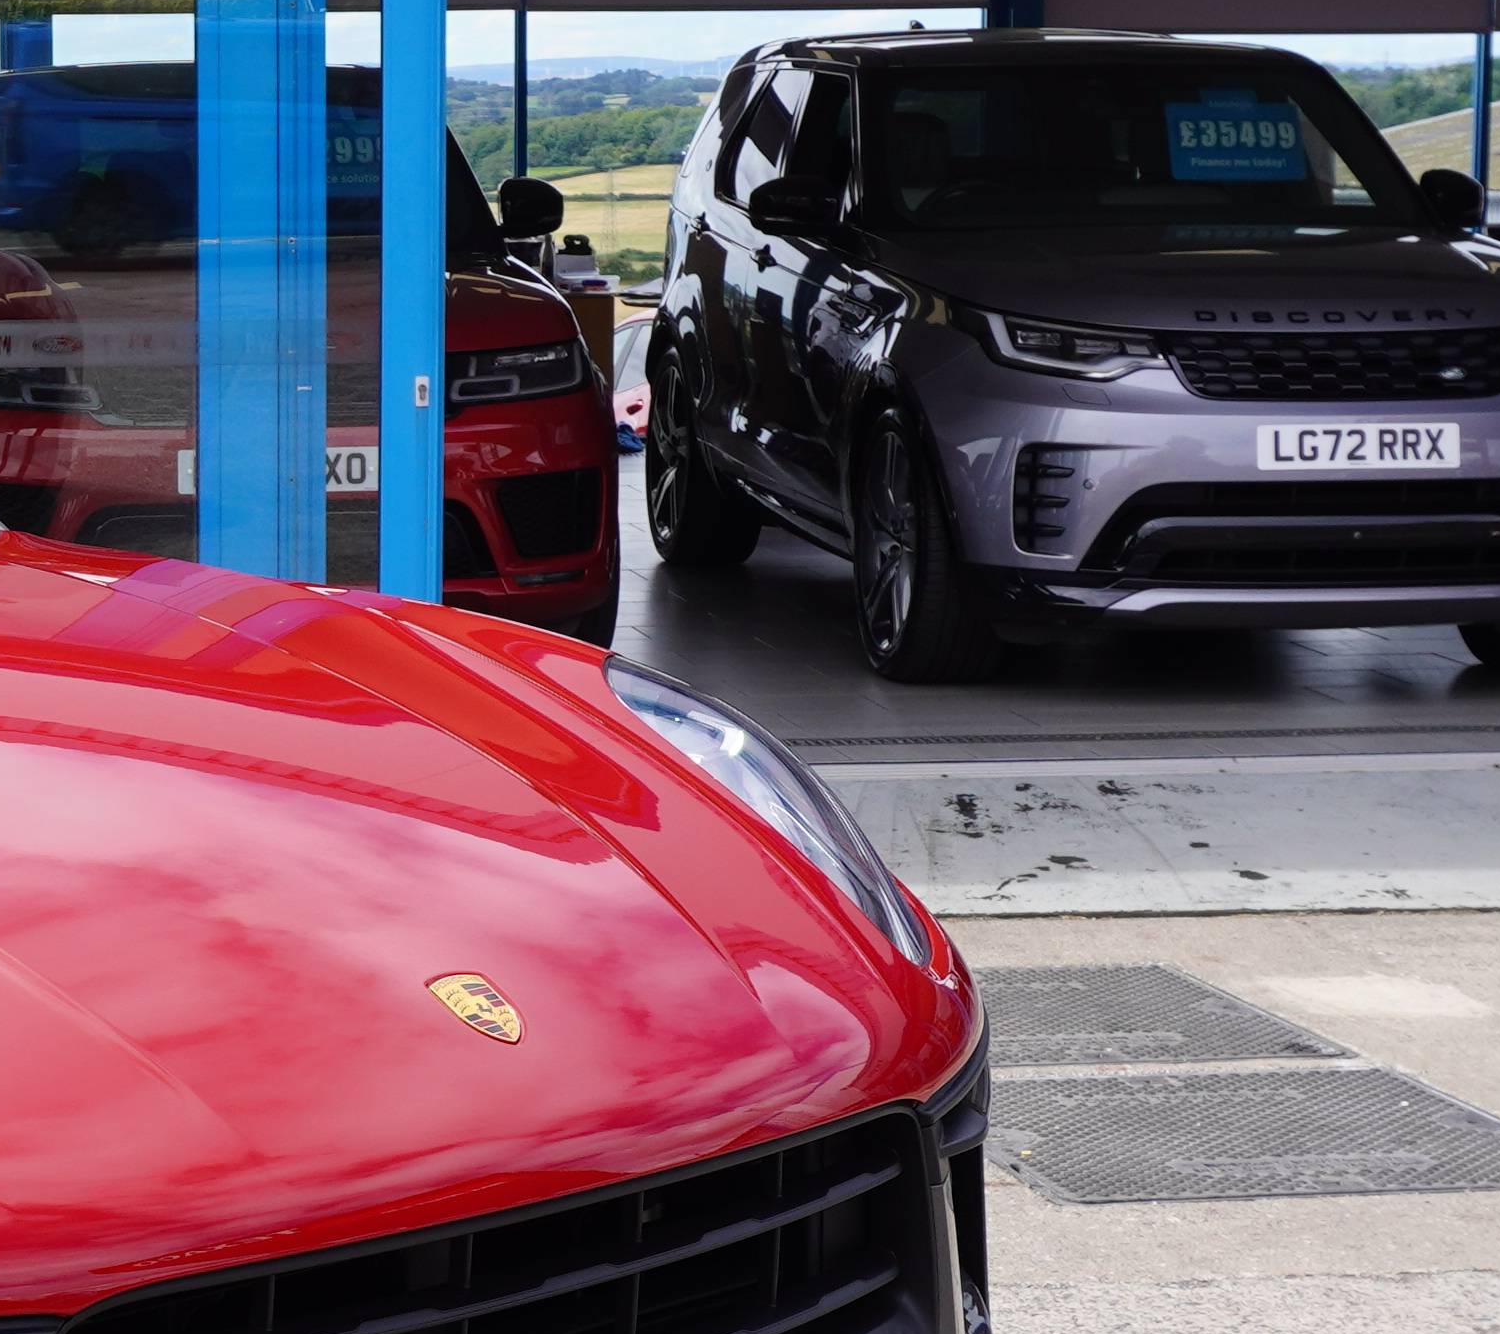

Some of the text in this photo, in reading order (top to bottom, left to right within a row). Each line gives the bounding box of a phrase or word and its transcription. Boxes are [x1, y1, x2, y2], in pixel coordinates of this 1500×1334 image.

[1178, 120, 1297, 149] £35499
[1194, 308, 1476, 324] DISCOVERY
[1273, 428, 1445, 462] LG72 RRX
